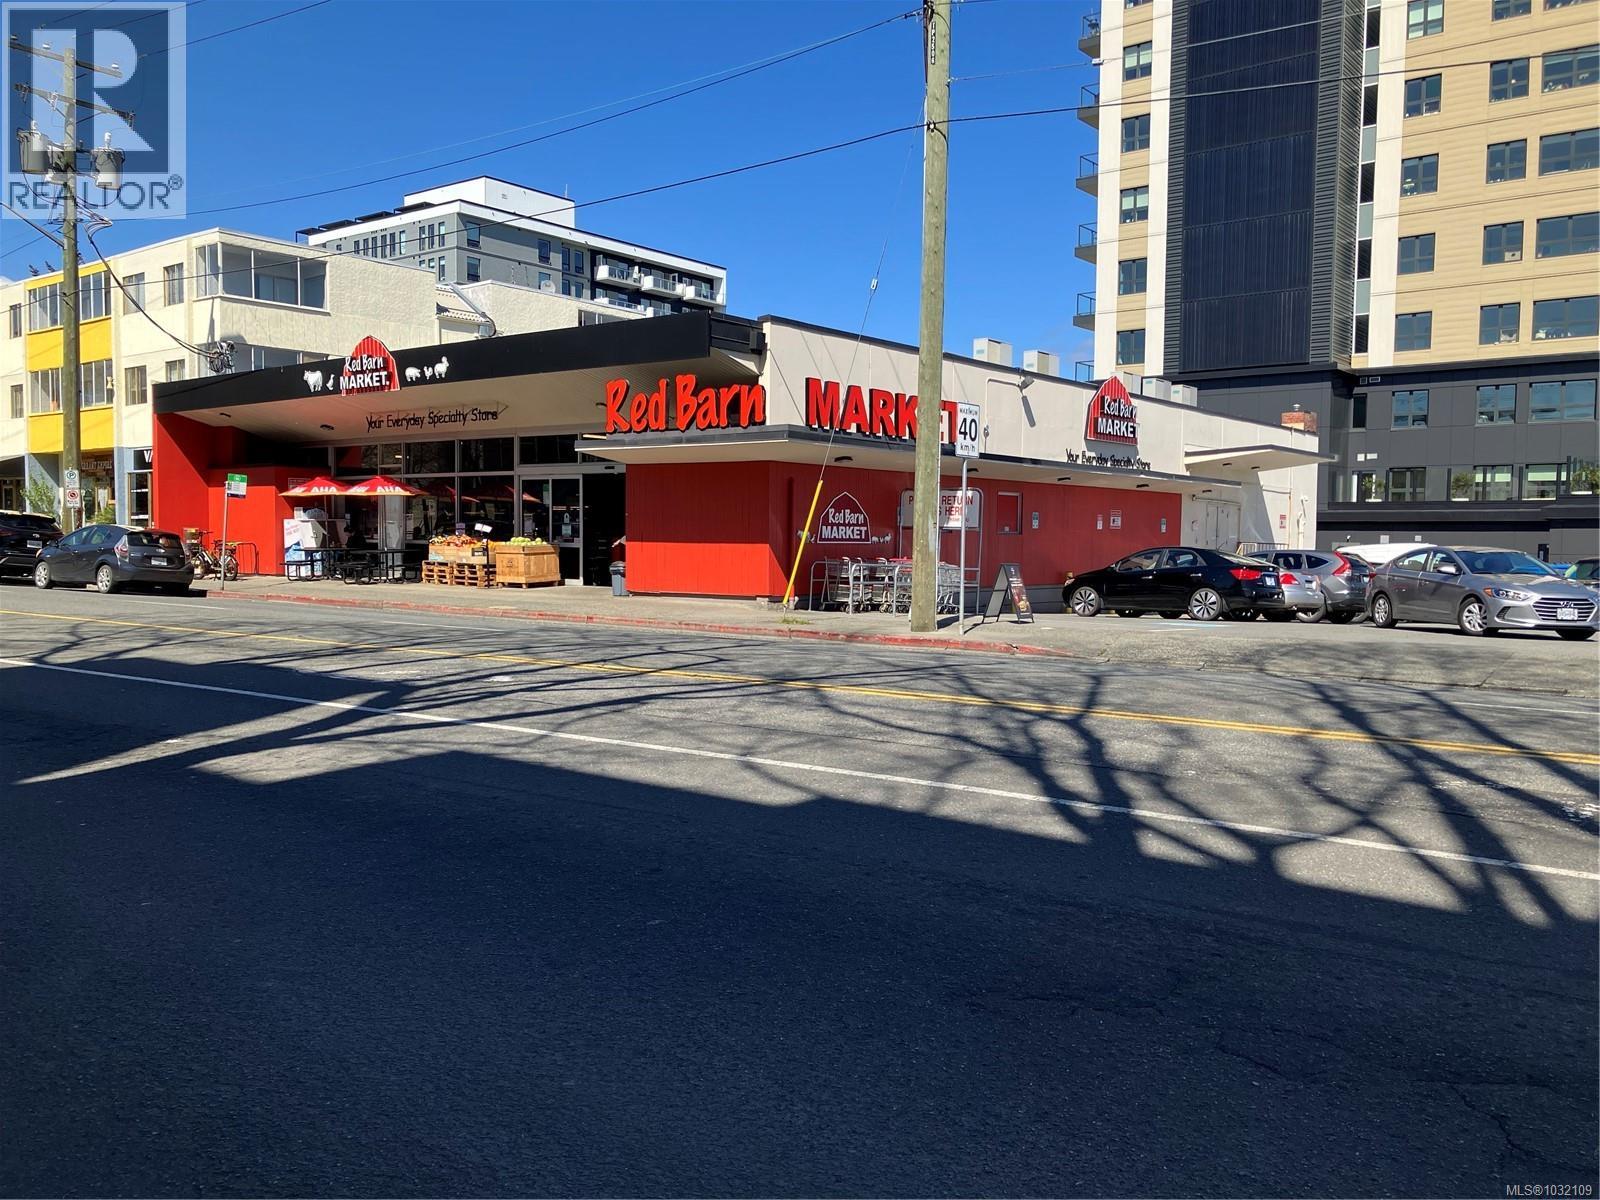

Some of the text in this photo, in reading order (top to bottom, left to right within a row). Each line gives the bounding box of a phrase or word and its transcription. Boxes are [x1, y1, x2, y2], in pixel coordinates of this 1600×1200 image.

[345, 354, 384, 372] Red Barn
[605, 373, 957, 443] Red Barn MARKT
[1104, 395, 1118, 415] Red
[366, 407, 498, 433] Your Everyday Specialty Store
[959, 417, 978, 442] 40
[1098, 417, 1140, 438] MARKET
[1065, 448, 1079, 463] Your
[828, 508, 864, 525] Red Barn
[821, 526, 868, 539] MARKET
